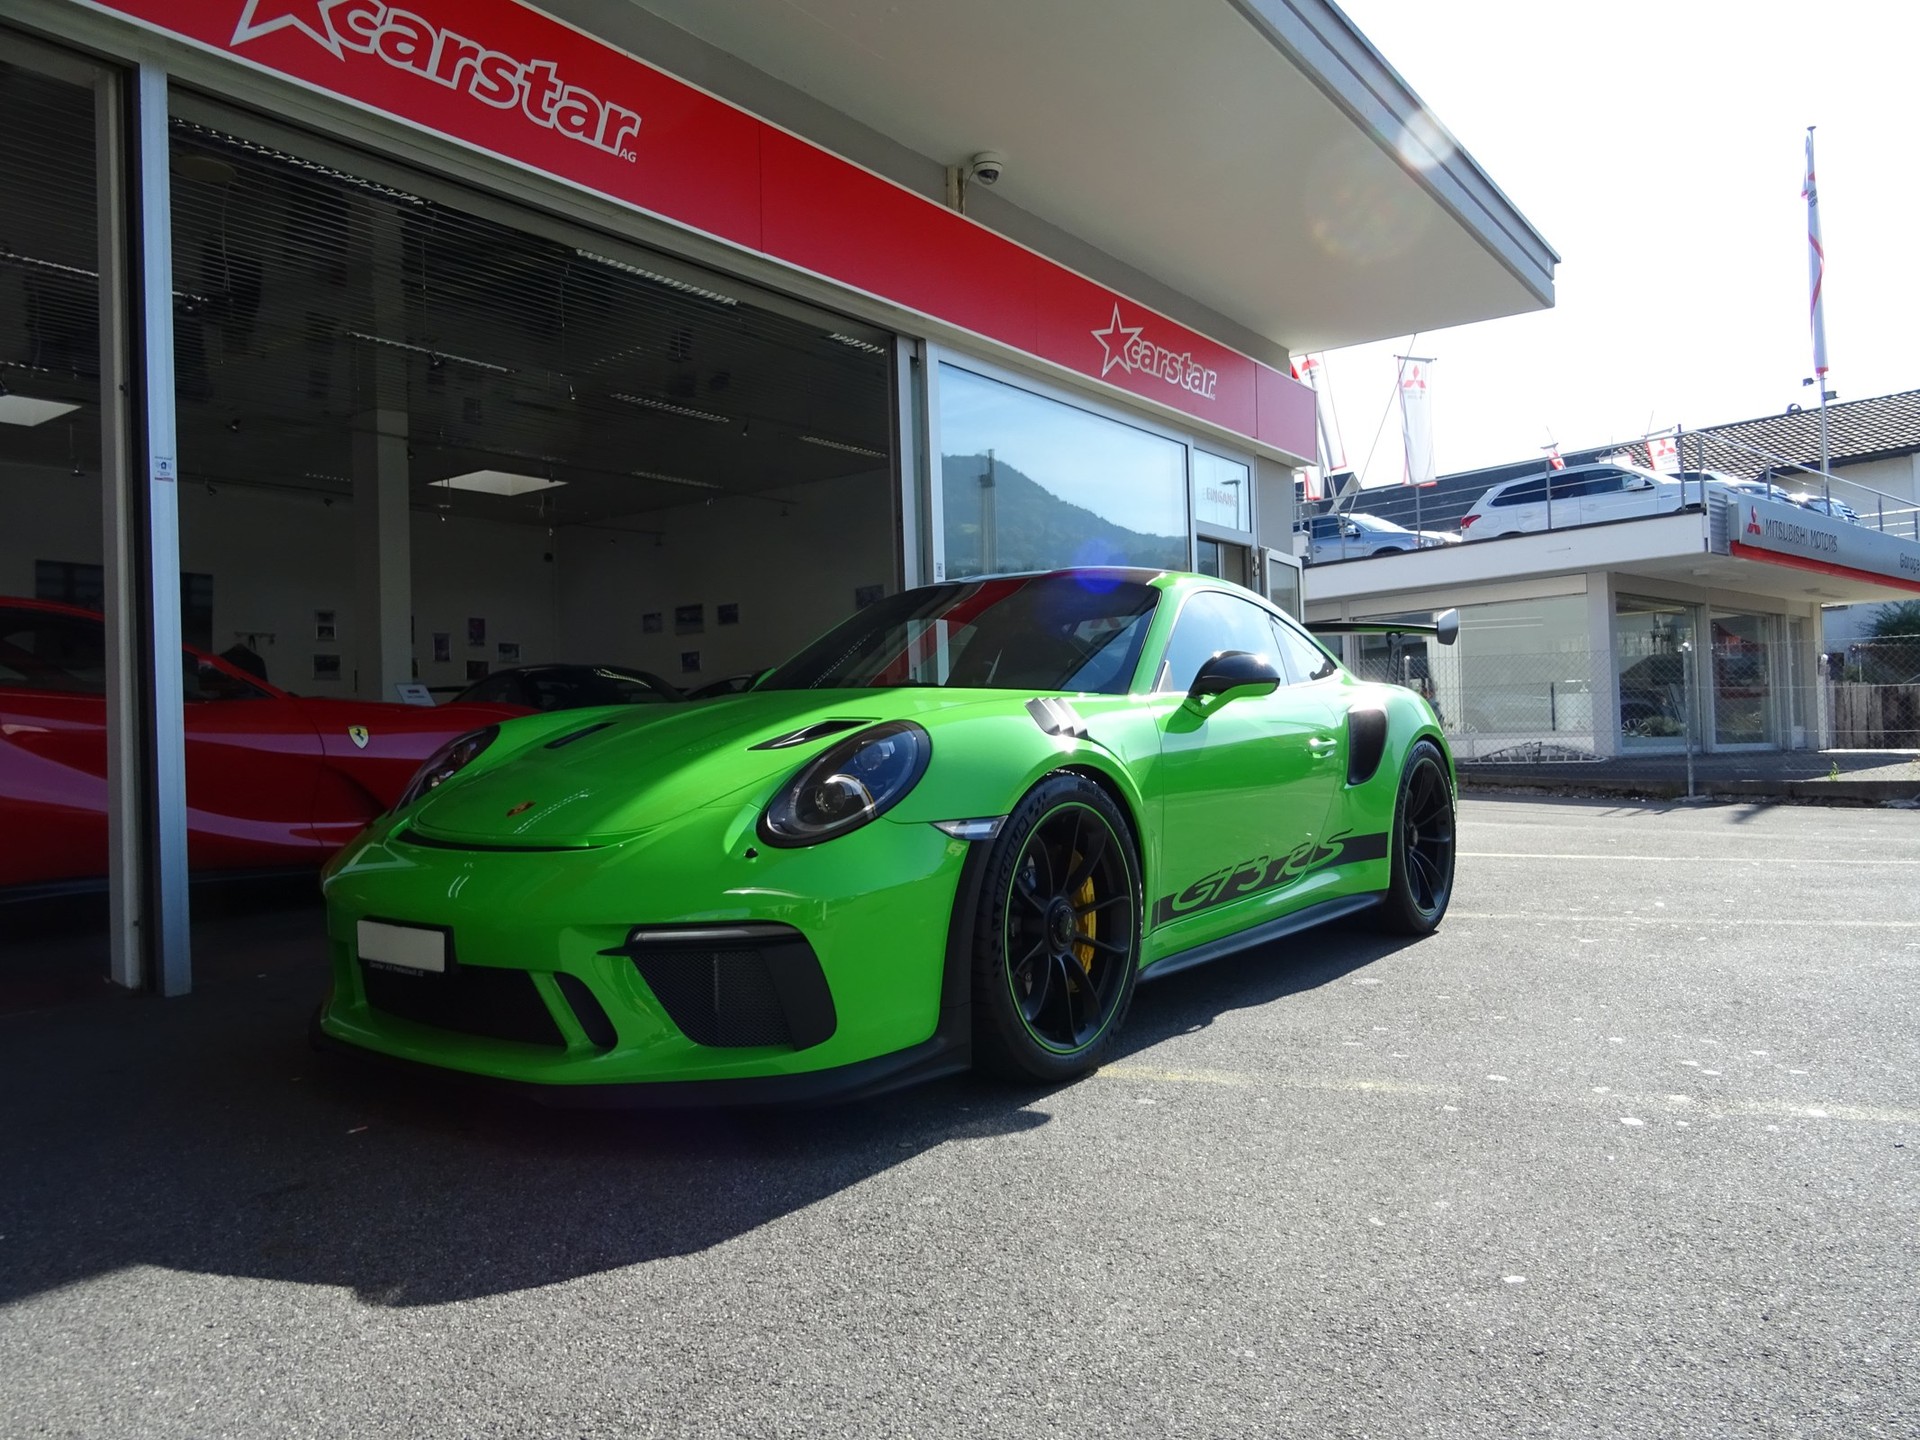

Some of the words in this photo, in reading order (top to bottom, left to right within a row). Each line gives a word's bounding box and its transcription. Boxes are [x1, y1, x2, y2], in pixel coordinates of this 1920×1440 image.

[324, 0, 641, 155] carstar
[619, 148, 637, 163] AG
[1129, 338, 1217, 398] carstar
[1765, 518, 1809, 545] MITSUBISHI
[1810, 529, 1838, 552] MOTORS
[1171, 855, 1273, 912] GT3
[1274, 828, 1354, 881] RS
